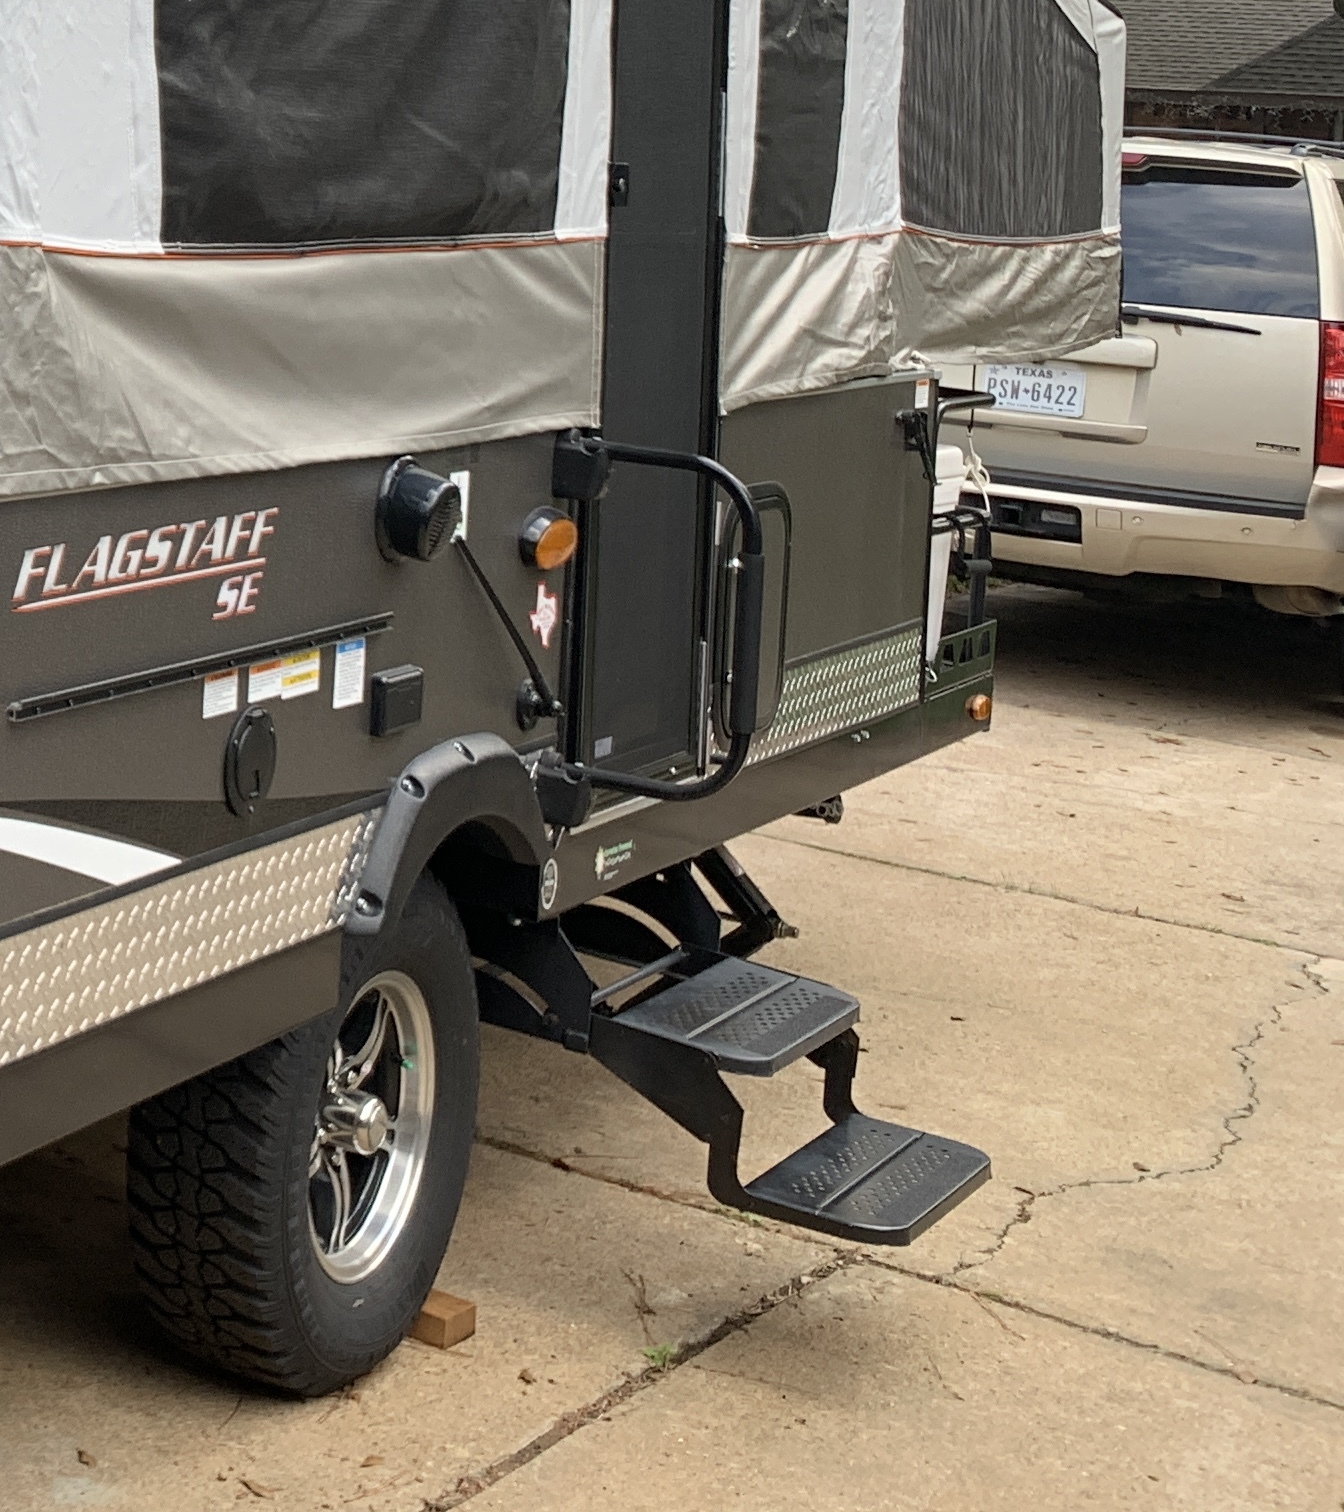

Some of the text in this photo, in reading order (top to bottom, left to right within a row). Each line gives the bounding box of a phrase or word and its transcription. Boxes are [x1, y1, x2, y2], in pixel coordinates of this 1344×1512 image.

[1014, 366, 1054, 379] TEXAS
[11, 506, 280, 602] FLAGSTAFF
[212, 571, 264, 620] SE
